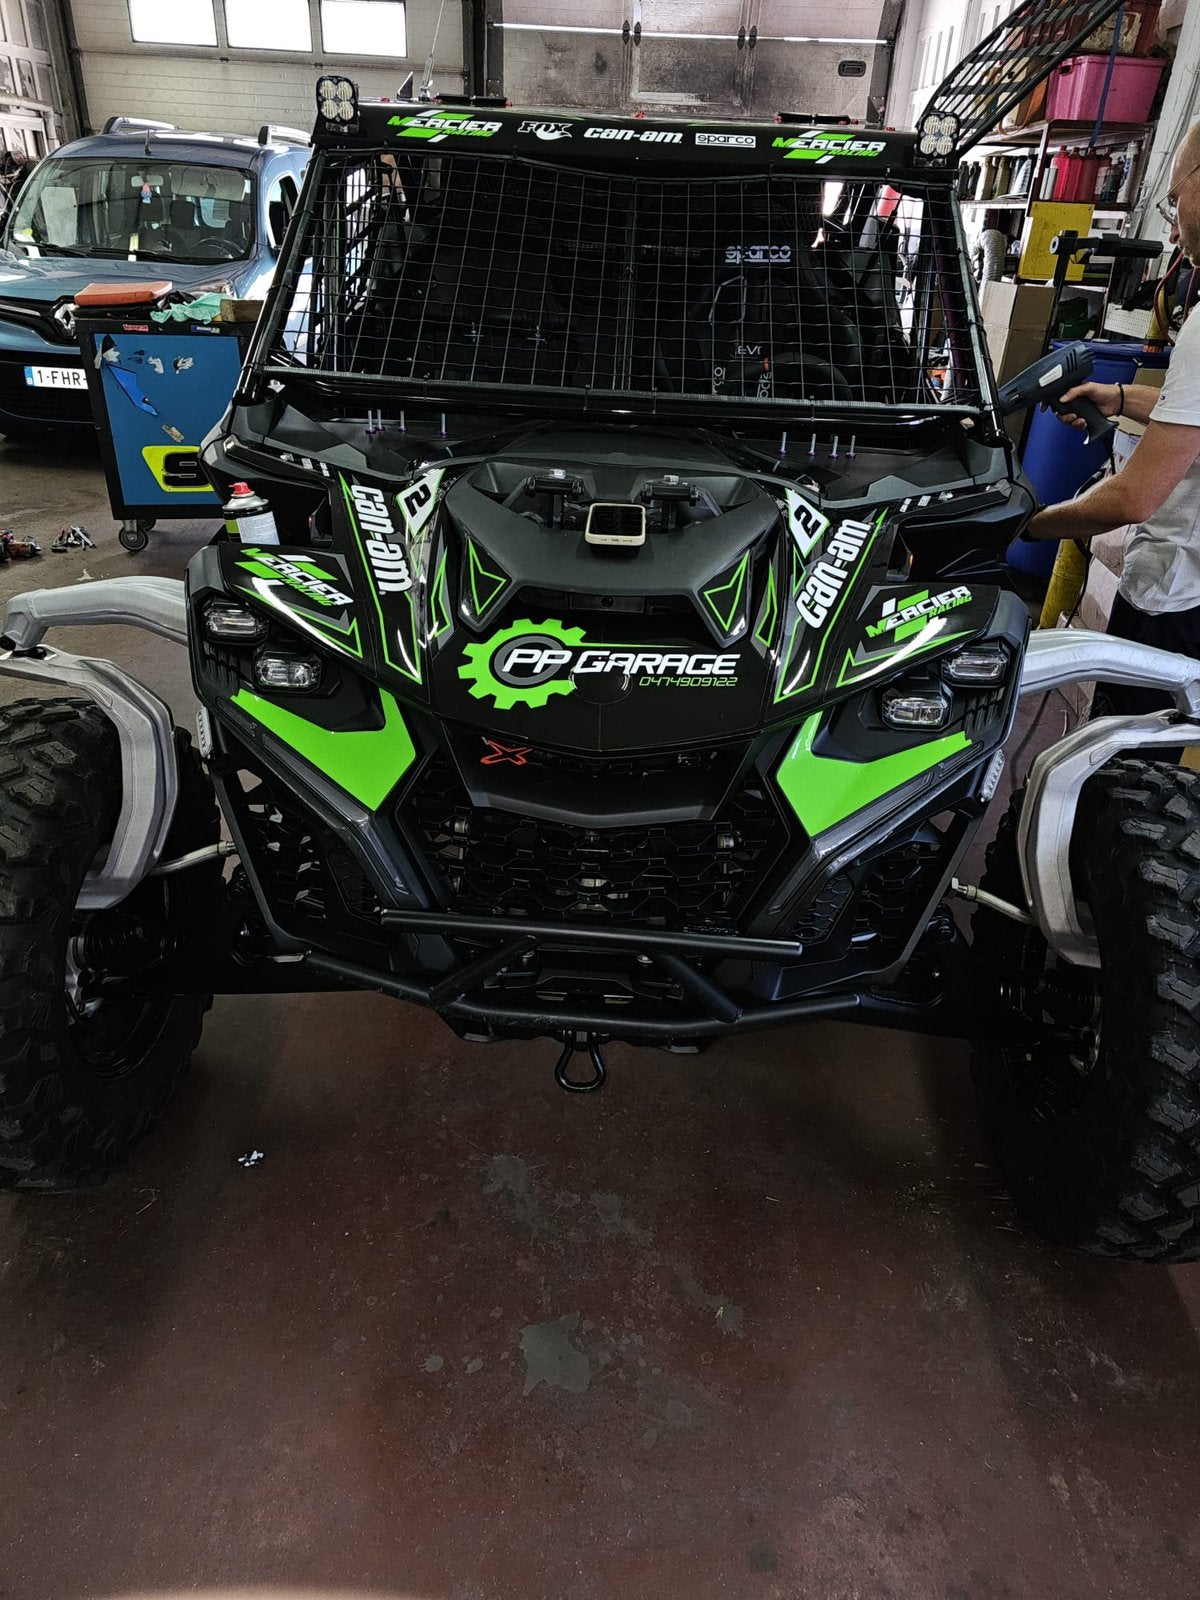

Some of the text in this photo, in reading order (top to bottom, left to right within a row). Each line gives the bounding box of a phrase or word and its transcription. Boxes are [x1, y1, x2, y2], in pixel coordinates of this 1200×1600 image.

[386, 115, 504, 133] MERCIER
[517, 121, 574, 138] FOX
[583, 127, 683, 144] can-am
[696, 134, 755, 147] sparco
[771, 137, 888, 152] MERCIER
[724, 245, 792, 264] sparco
[403, 483, 432, 517] 2
[794, 504, 822, 539] 2
[351, 484, 413, 593] can-am
[240, 547, 354, 606] MERCIER
[796, 519, 871, 629] can-am
[865, 585, 972, 638] MERCIER
[928, 594, 973, 618] RACING
[502, 648, 741, 675] PP GARAGE
[639, 676, 738, 687] 0474909122
